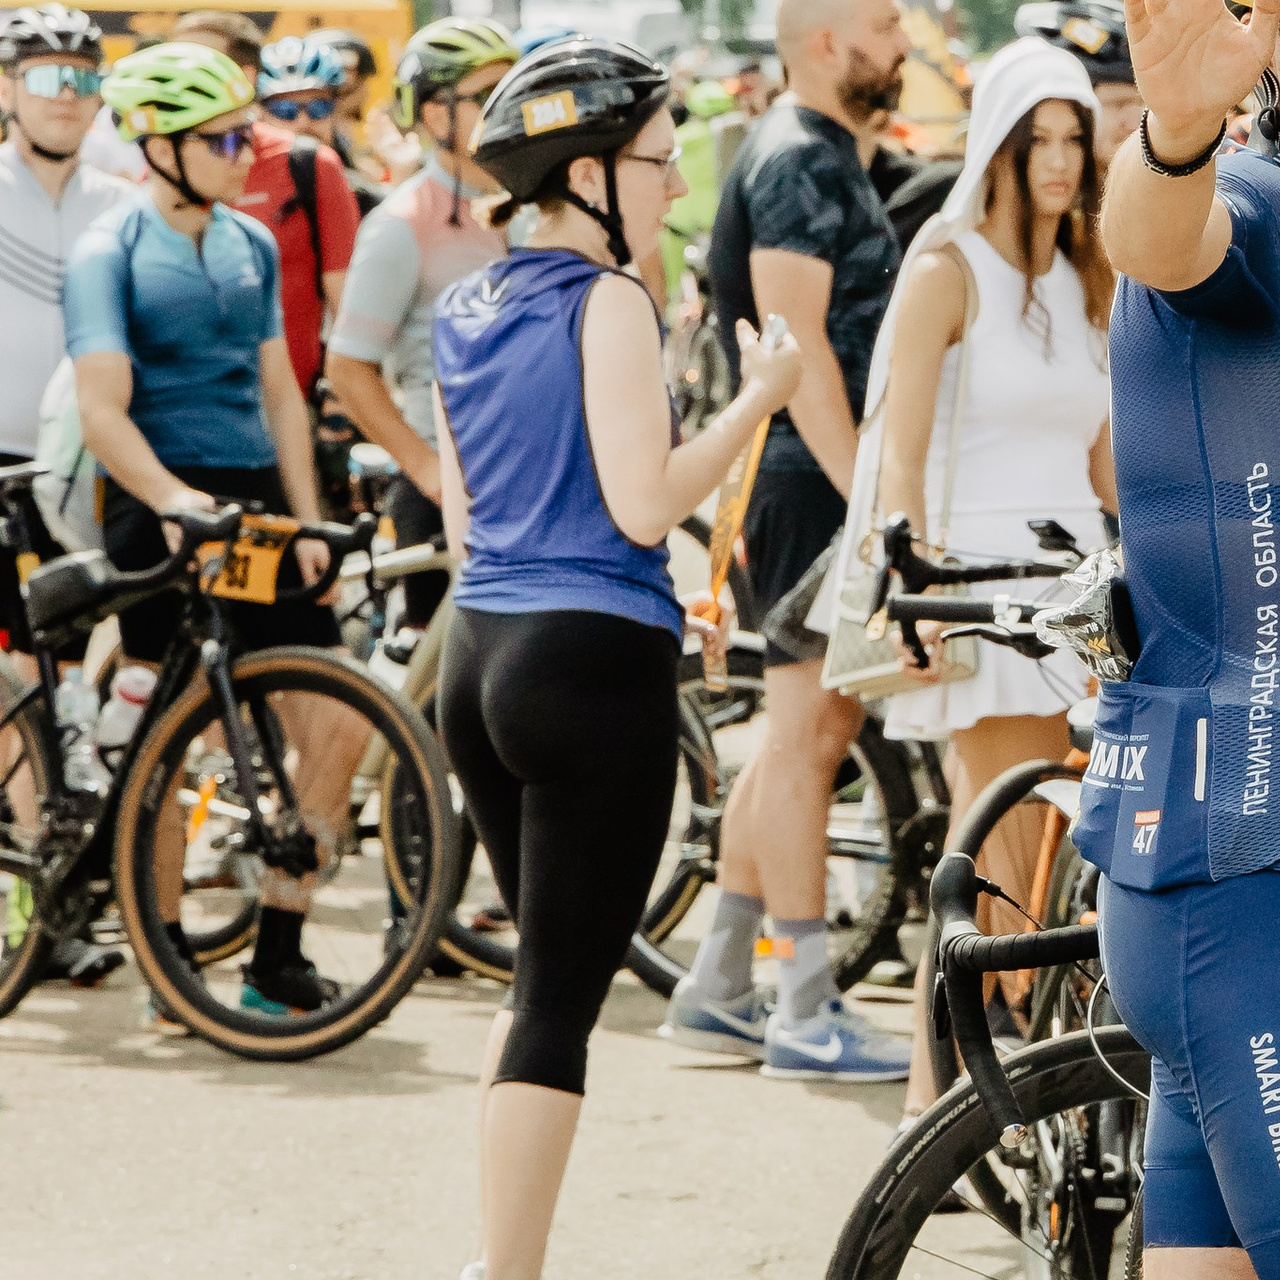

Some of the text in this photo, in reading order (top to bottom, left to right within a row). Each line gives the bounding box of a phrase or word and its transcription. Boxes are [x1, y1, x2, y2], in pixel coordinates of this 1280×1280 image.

[1243, 462, 1280, 816] ЛЕНИНГРАДСКАЯ ОБЛАСТЬ
[1133, 824, 1157, 854] 47
